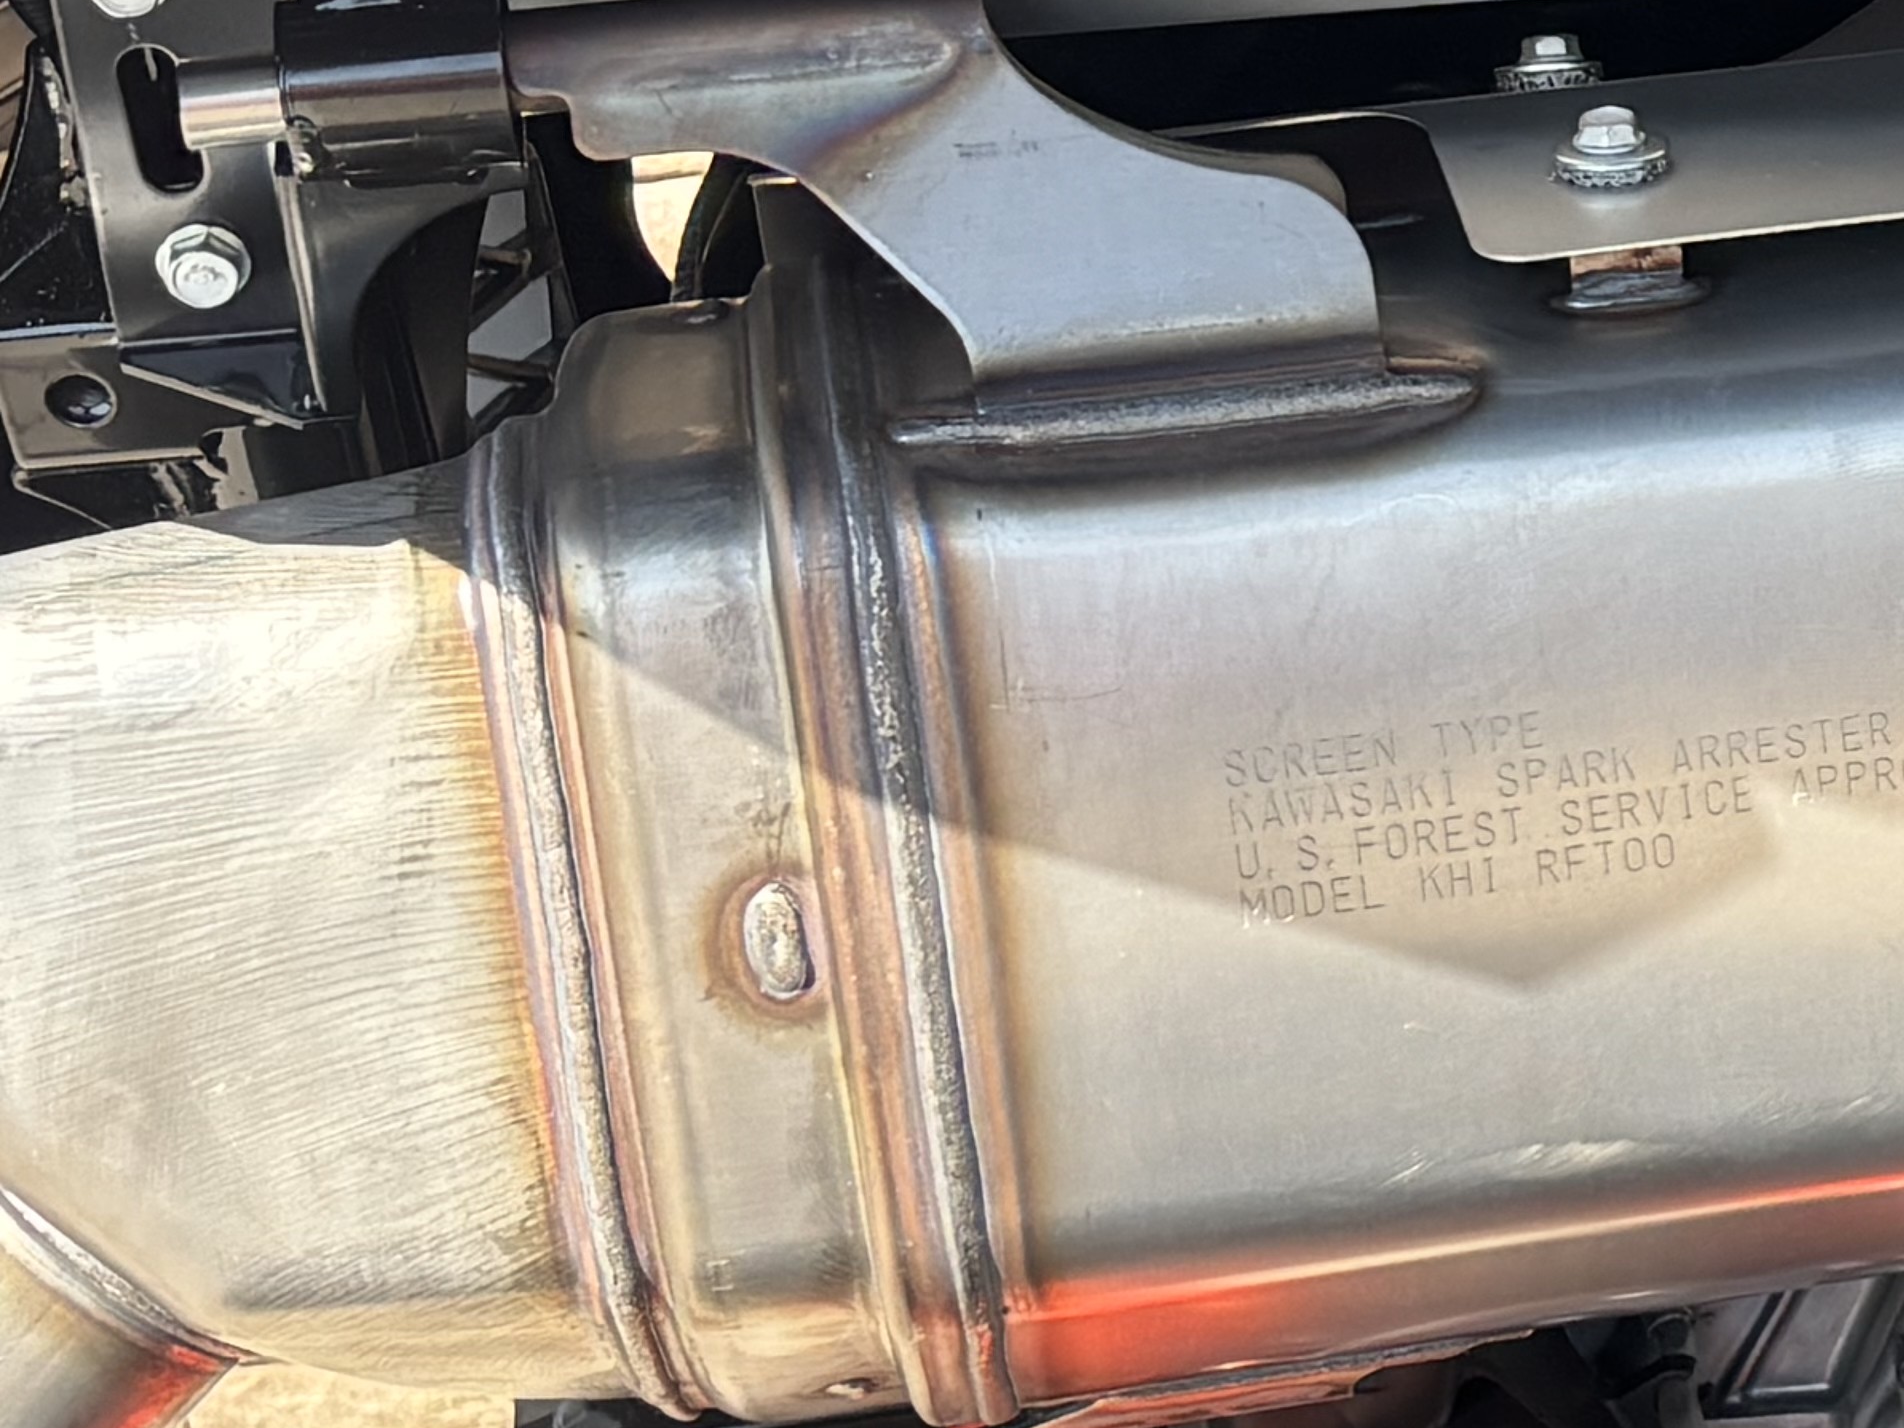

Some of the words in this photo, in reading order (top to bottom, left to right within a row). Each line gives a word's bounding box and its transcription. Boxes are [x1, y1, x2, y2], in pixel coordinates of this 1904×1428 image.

[1223, 728, 1398, 789] SCREEN
[1430, 709, 1546, 760] TYPE
[1228, 768, 1459, 837] KAWASAKI
[1496, 744, 1638, 799] SPARK
[1670, 710, 1893, 776] ARRESTER
[1352, 805, 1524, 867] FOREST
[1558, 774, 1755, 837] SERVICE
[1238, 872, 1387, 930] MODEL
[1419, 855, 1502, 904] KHI
